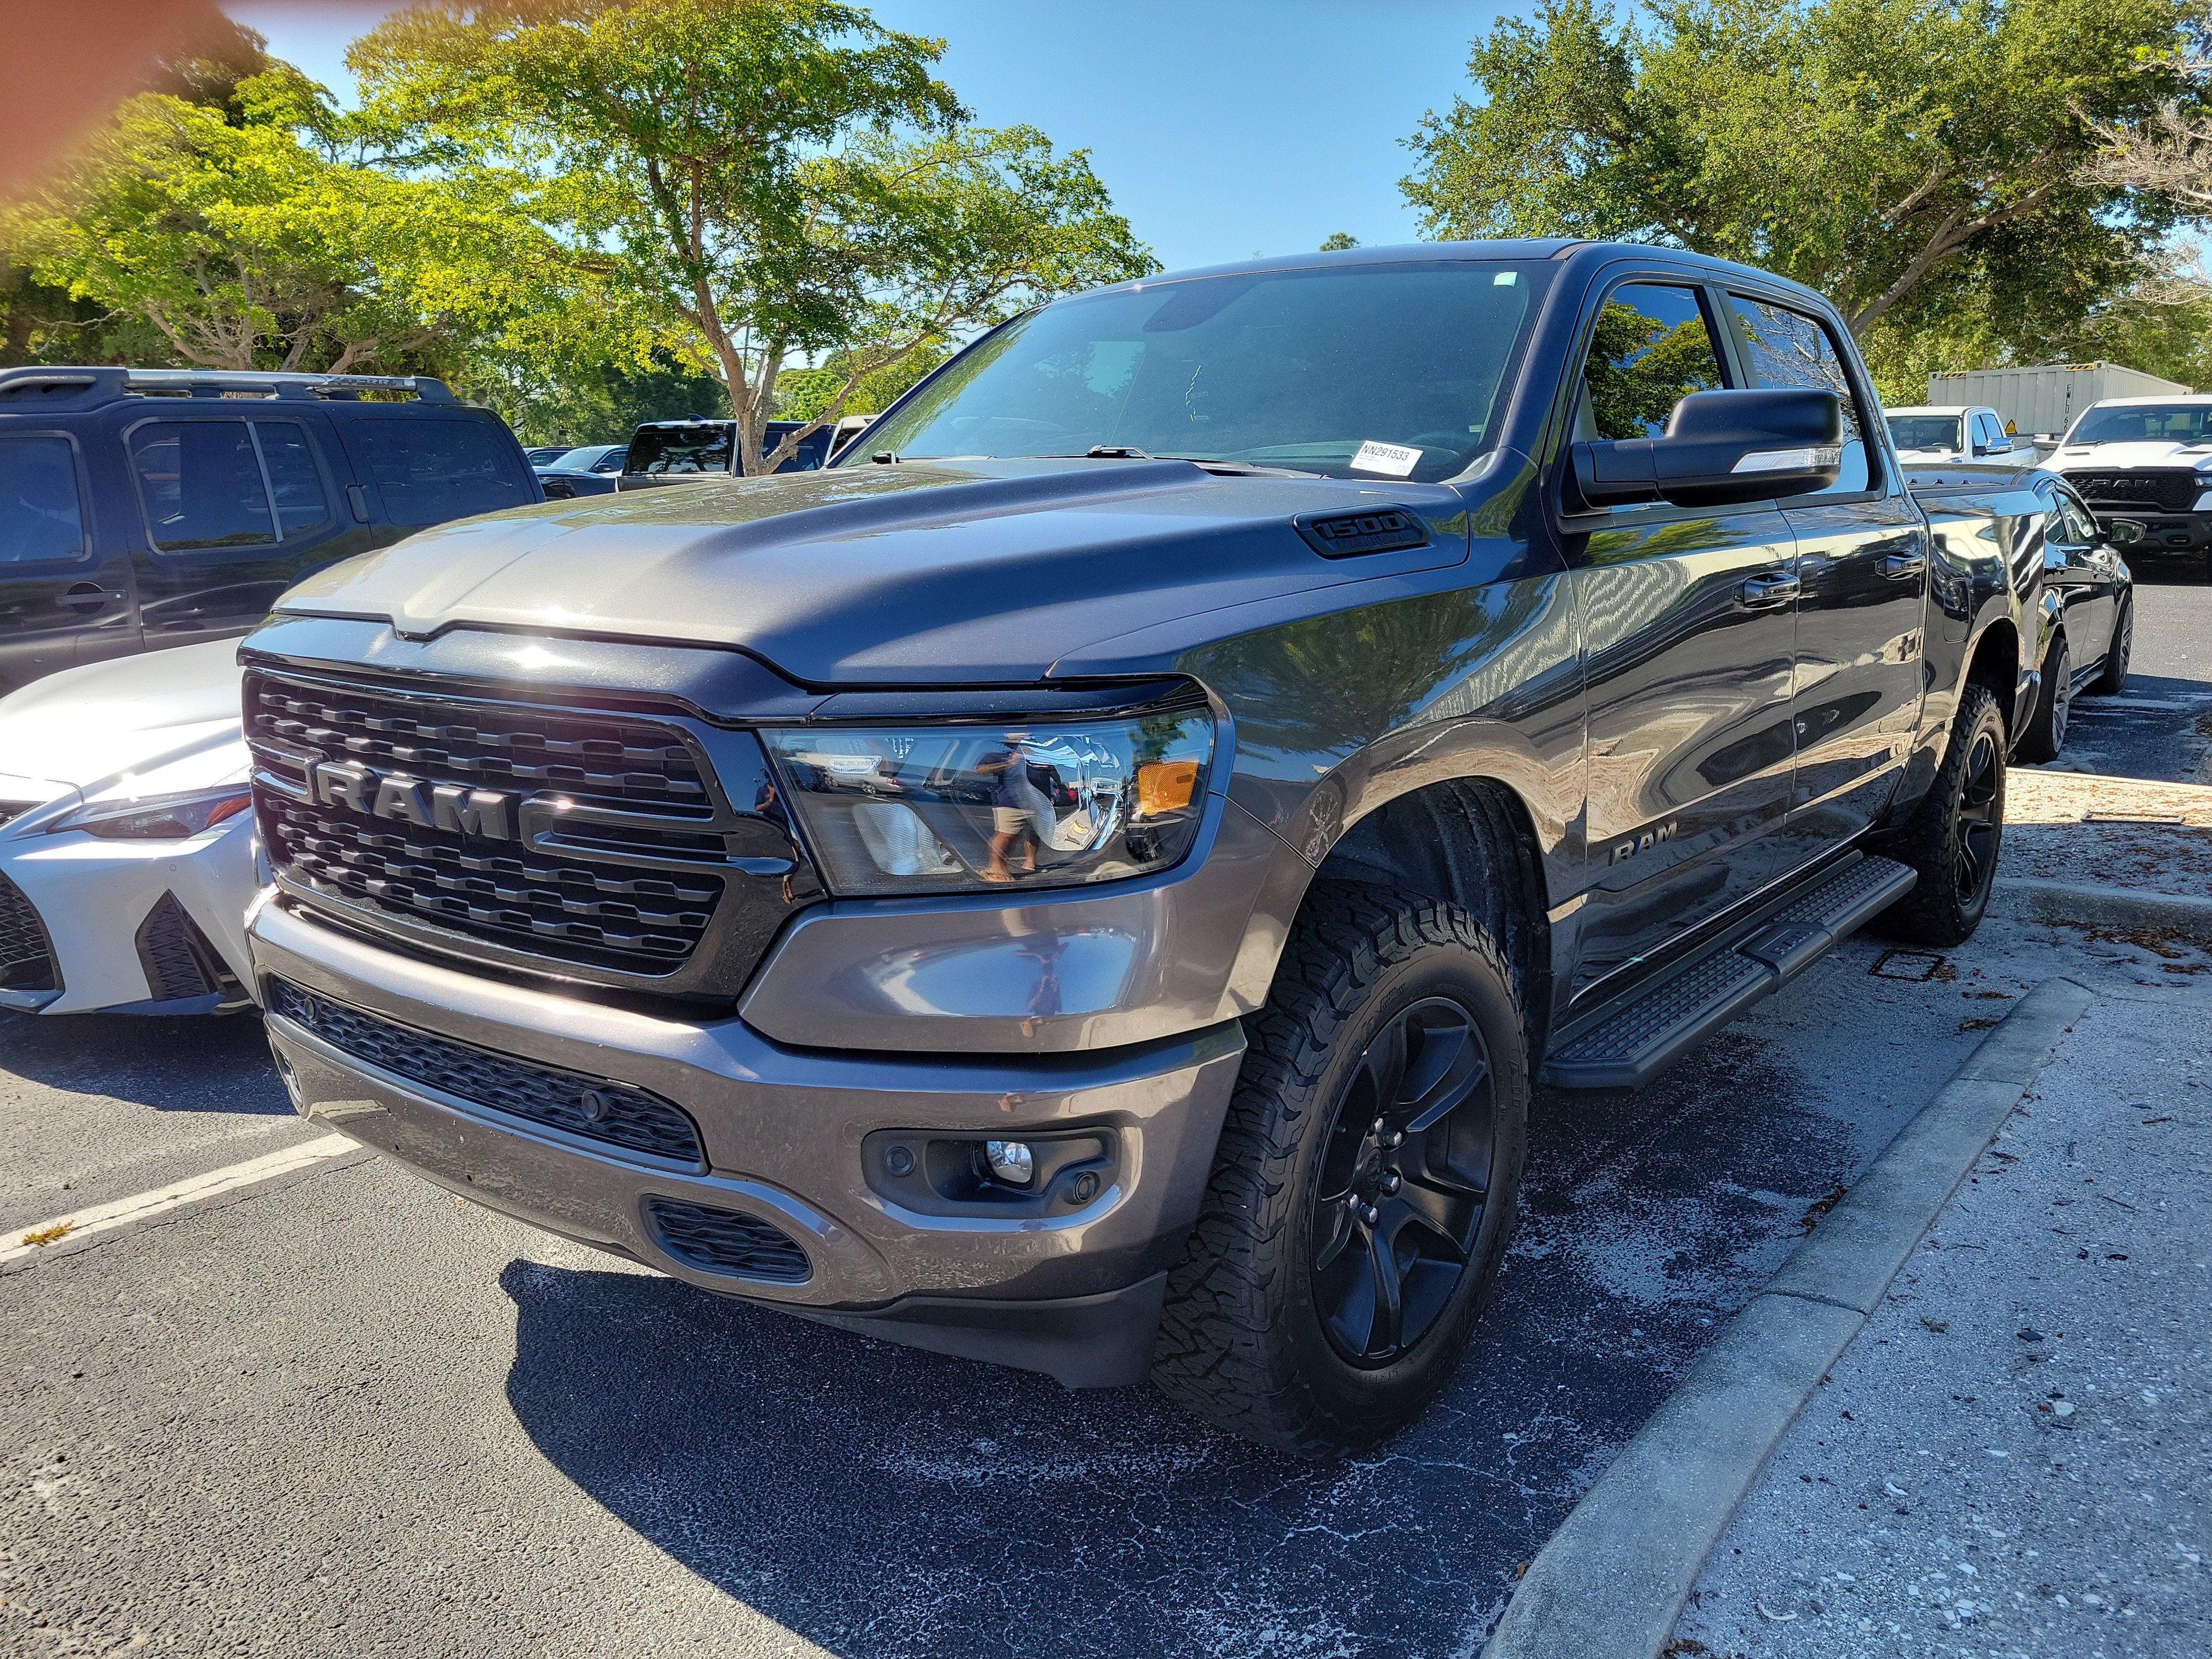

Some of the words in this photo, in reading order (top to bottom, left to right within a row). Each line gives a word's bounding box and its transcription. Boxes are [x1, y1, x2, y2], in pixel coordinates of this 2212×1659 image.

[1361, 444, 1410, 461] NN291533
[2092, 479, 2157, 488] RAM
[1315, 513, 1409, 538] 1500
[316, 759, 510, 840] RAM
[1608, 821, 1678, 867] RAM
